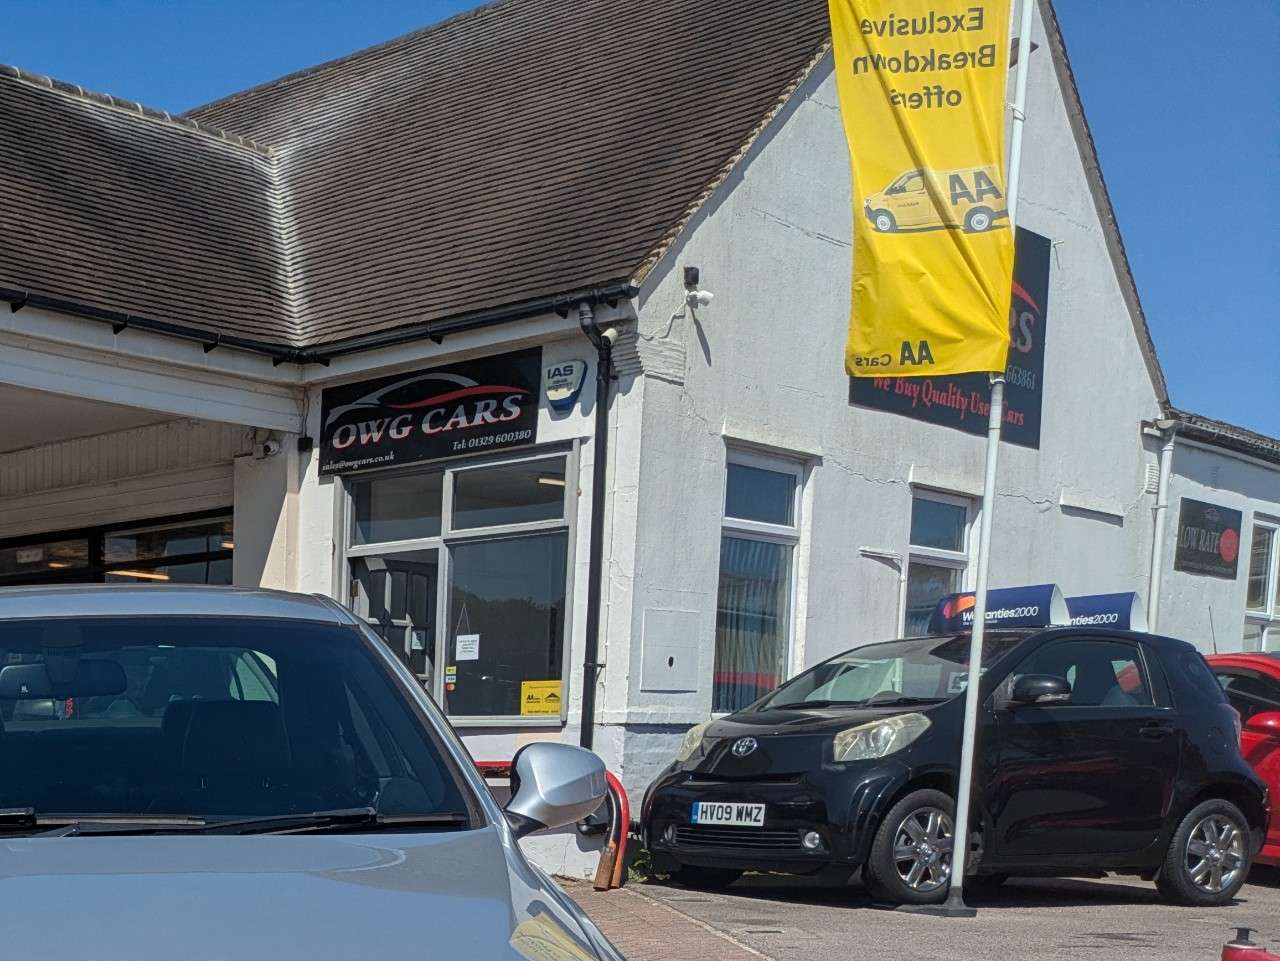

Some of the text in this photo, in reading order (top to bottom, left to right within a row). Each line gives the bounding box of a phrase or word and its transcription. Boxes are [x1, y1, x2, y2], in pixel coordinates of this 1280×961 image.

[547, 364, 574, 380] IAS
[895, 376, 920, 409] Buy
[922, 379, 969, 420] Quality
[970, 391, 991, 416] Use
[332, 394, 523, 449] OWG CARS
[468, 435, 494, 448] 01329
[495, 429, 532, 443] 600380
[962, 606, 1039, 621] Wanties2000
[700, 804, 763, 823] HV09 WMZ
